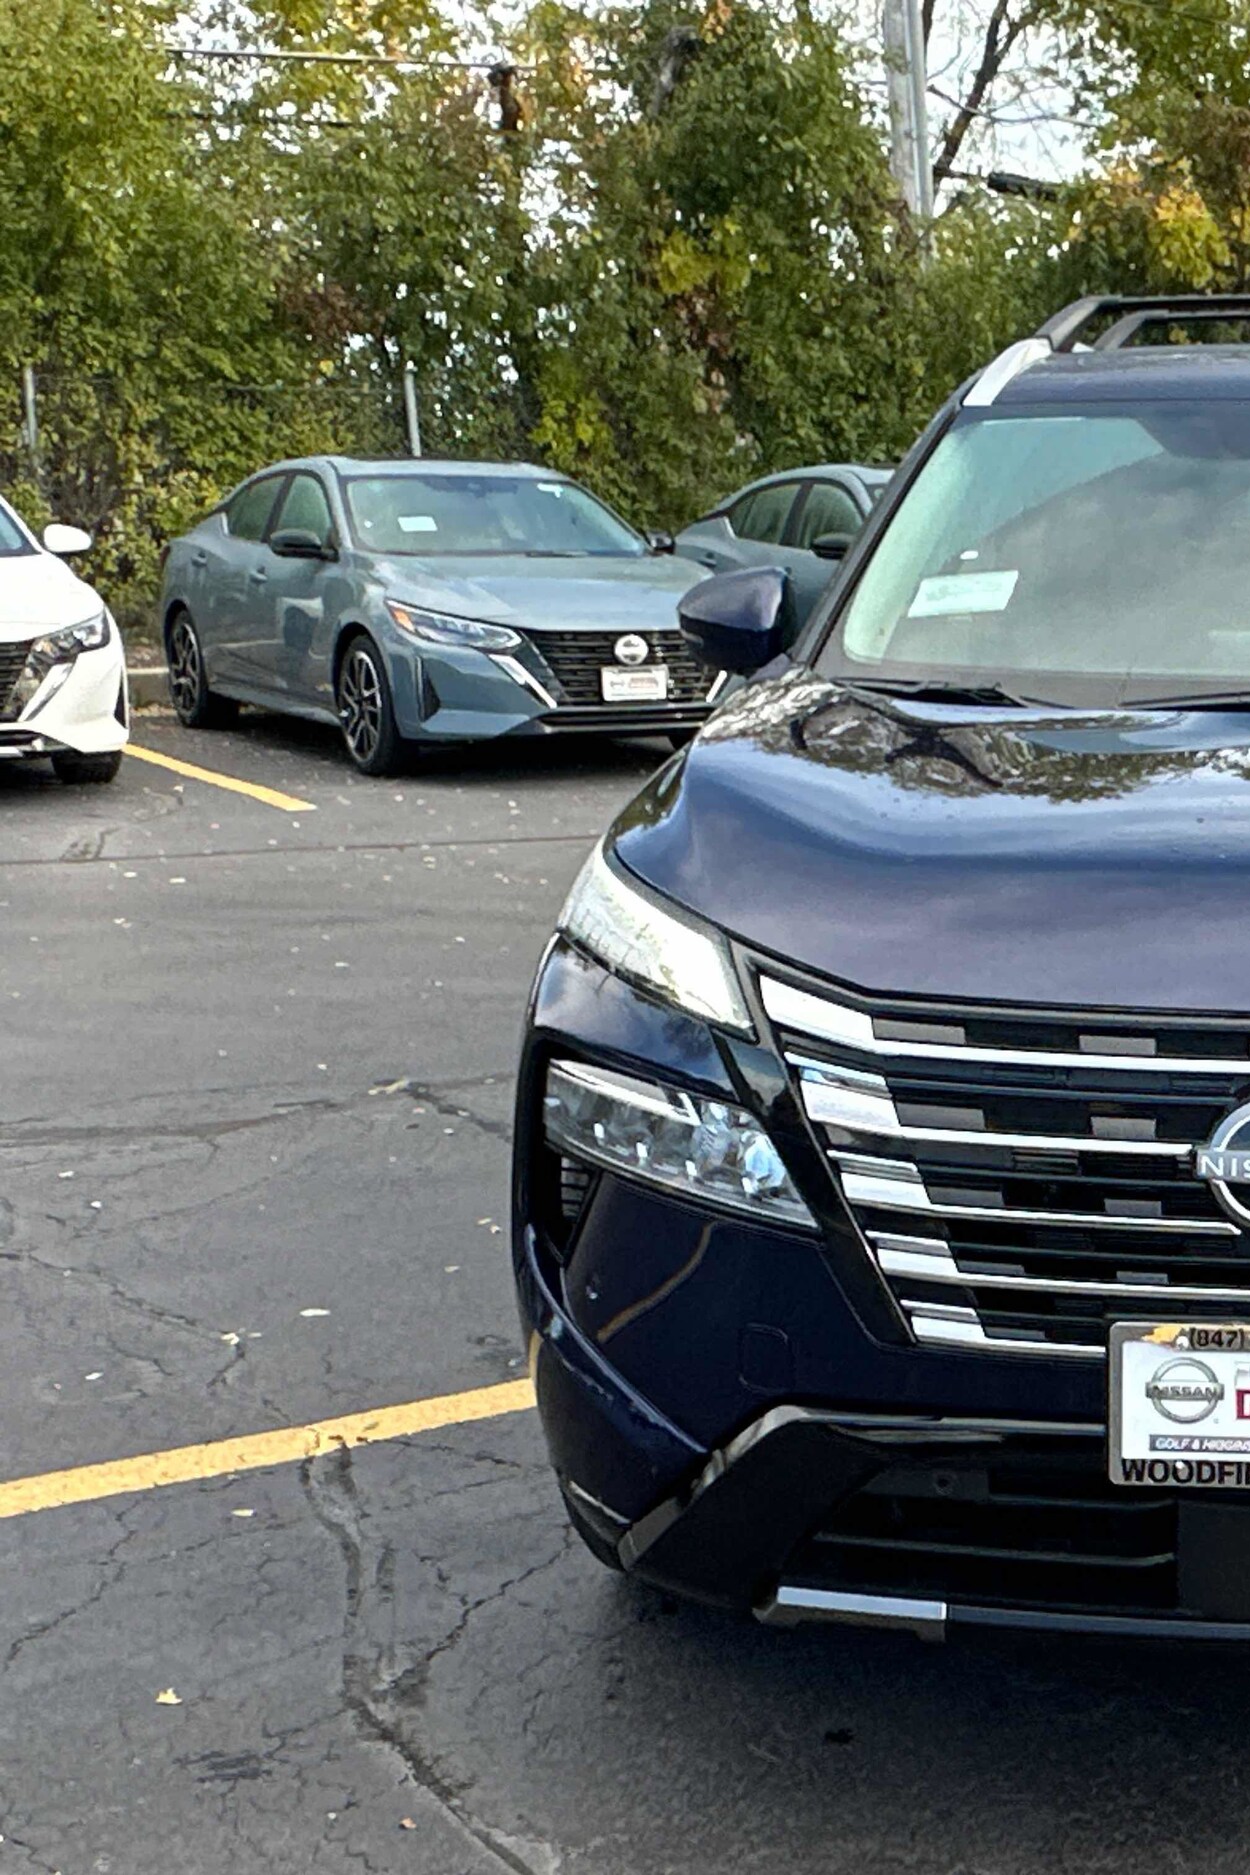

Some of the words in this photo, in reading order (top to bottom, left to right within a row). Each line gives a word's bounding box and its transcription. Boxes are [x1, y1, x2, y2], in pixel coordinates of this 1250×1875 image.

[1189, 1327, 1244, 1349] (847)
[1152, 1384, 1218, 1399] NISSAN
[1155, 1437, 1190, 1450] GOLF
